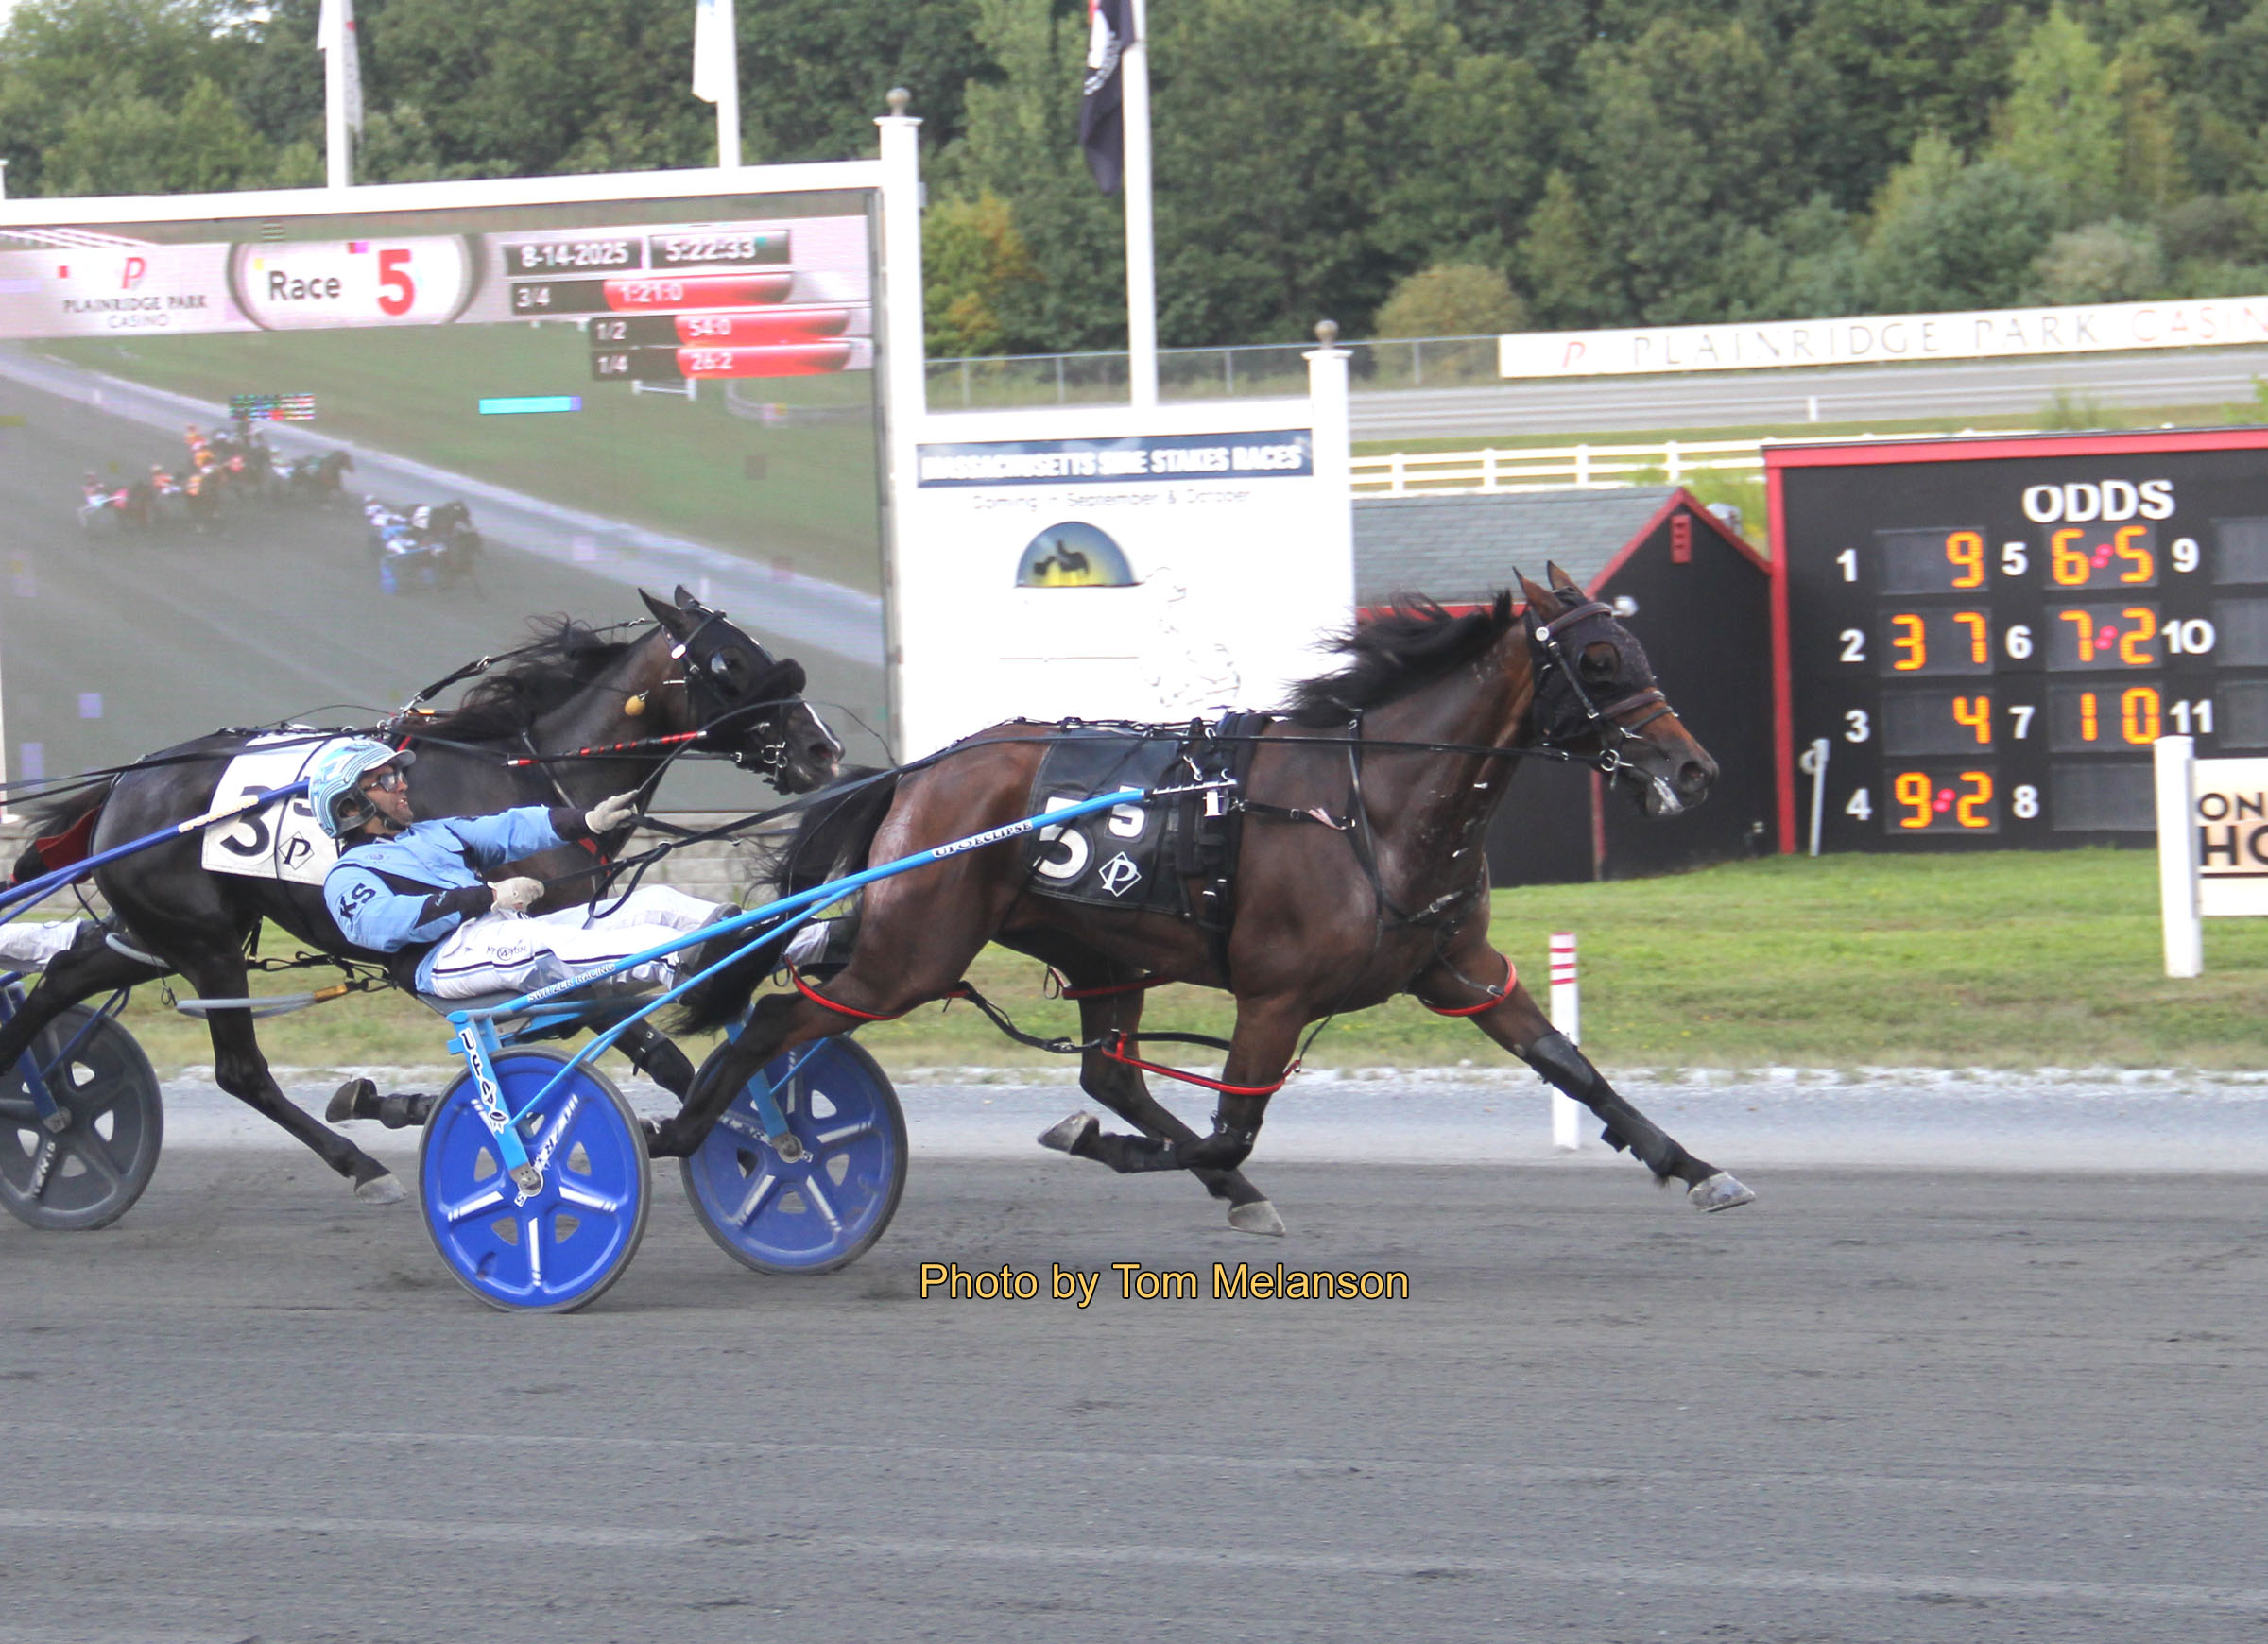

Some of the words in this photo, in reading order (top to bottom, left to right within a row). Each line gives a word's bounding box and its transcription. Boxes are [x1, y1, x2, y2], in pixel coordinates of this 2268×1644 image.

[522, 242, 628, 267] 8-14-2025
[268, 270, 341, 300] Race
[378, 248, 415, 316] 5
[516, 287, 550, 308] 3/4
[62, 297, 162, 313] PLAINRIDGE
[167, 294, 209, 310] PARK
[108, 313, 170, 329] CASINO
[1634, 322, 1939, 366] PLAINRIDGE
[1974, 314, 2098, 350] PARK
[1150, 446, 1229, 473] STAKES
[1231, 444, 1304, 471] RACES
[2022, 479, 2175, 523] ODDS
[1836, 549, 1858, 582] 1
[1945, 532, 1984, 588] 9
[2001, 541, 2029, 576] 5
[2172, 538, 2201, 573] 9
[1839, 629, 1866, 662] 2
[2005, 625, 2033, 659] 6
[2161, 620, 2216, 655] 10
[1845, 710, 1871, 744] 3
[1952, 695, 1991, 745] 4
[2008, 706, 2036, 739] 7
[2170, 699, 2214, 734] 11
[219, 785, 271, 857] 3
[1846, 788, 1873, 821] 4
[2012, 784, 2040, 819] 8
[527, 978, 574, 1002] SWITZER
[575, 964, 615, 985] RACING
